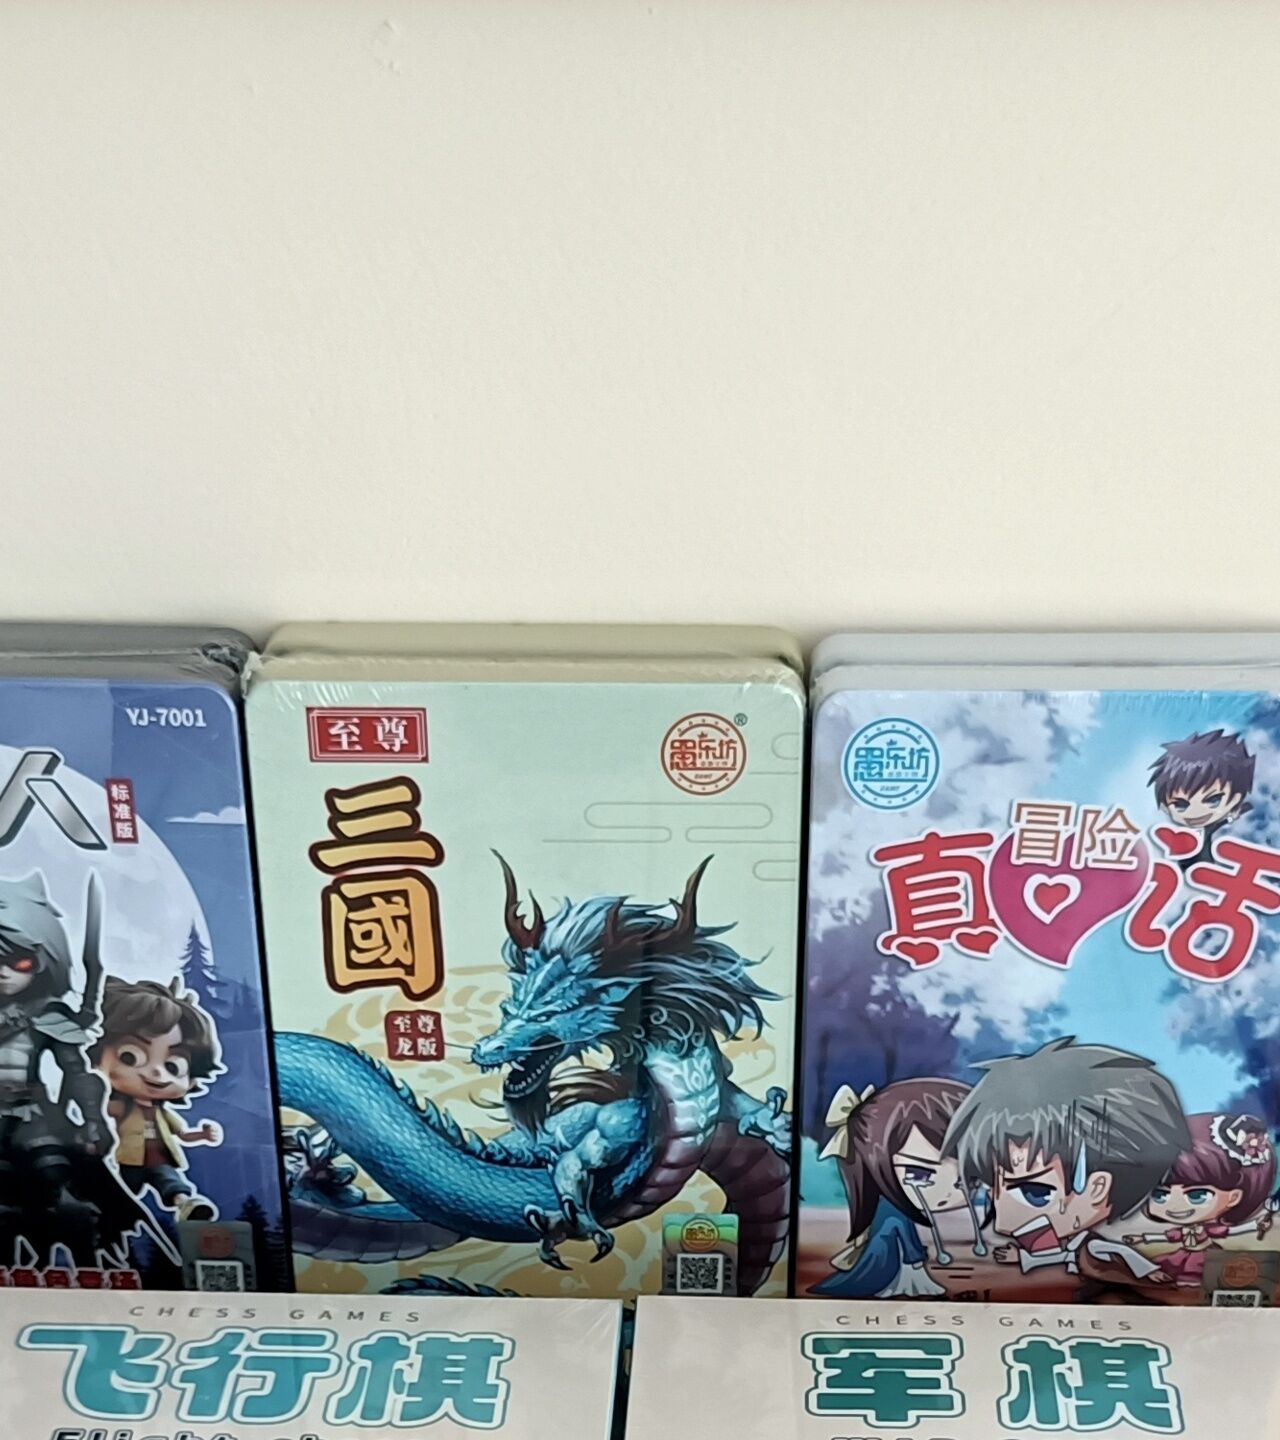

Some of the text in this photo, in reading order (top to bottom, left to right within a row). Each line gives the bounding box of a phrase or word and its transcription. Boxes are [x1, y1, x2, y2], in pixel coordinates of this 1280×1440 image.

[125, 707, 207, 728] YJ-7001
[327, 717, 409, 752] 至尊
[111, 784, 134, 838] 标准版
[1009, 800, 1142, 870] 冒险
[308, 775, 445, 1001] 三國
[394, 1015, 436, 1034] 至尊
[394, 1037, 437, 1057] 龙版
[128, 1306, 421, 1322] CHESS GAMES
[836, 1315, 1132, 1331] CHESS GAMES
[16, 1323, 517, 1431] 飞行棋
[800, 1331, 1185, 1434] 军棋
